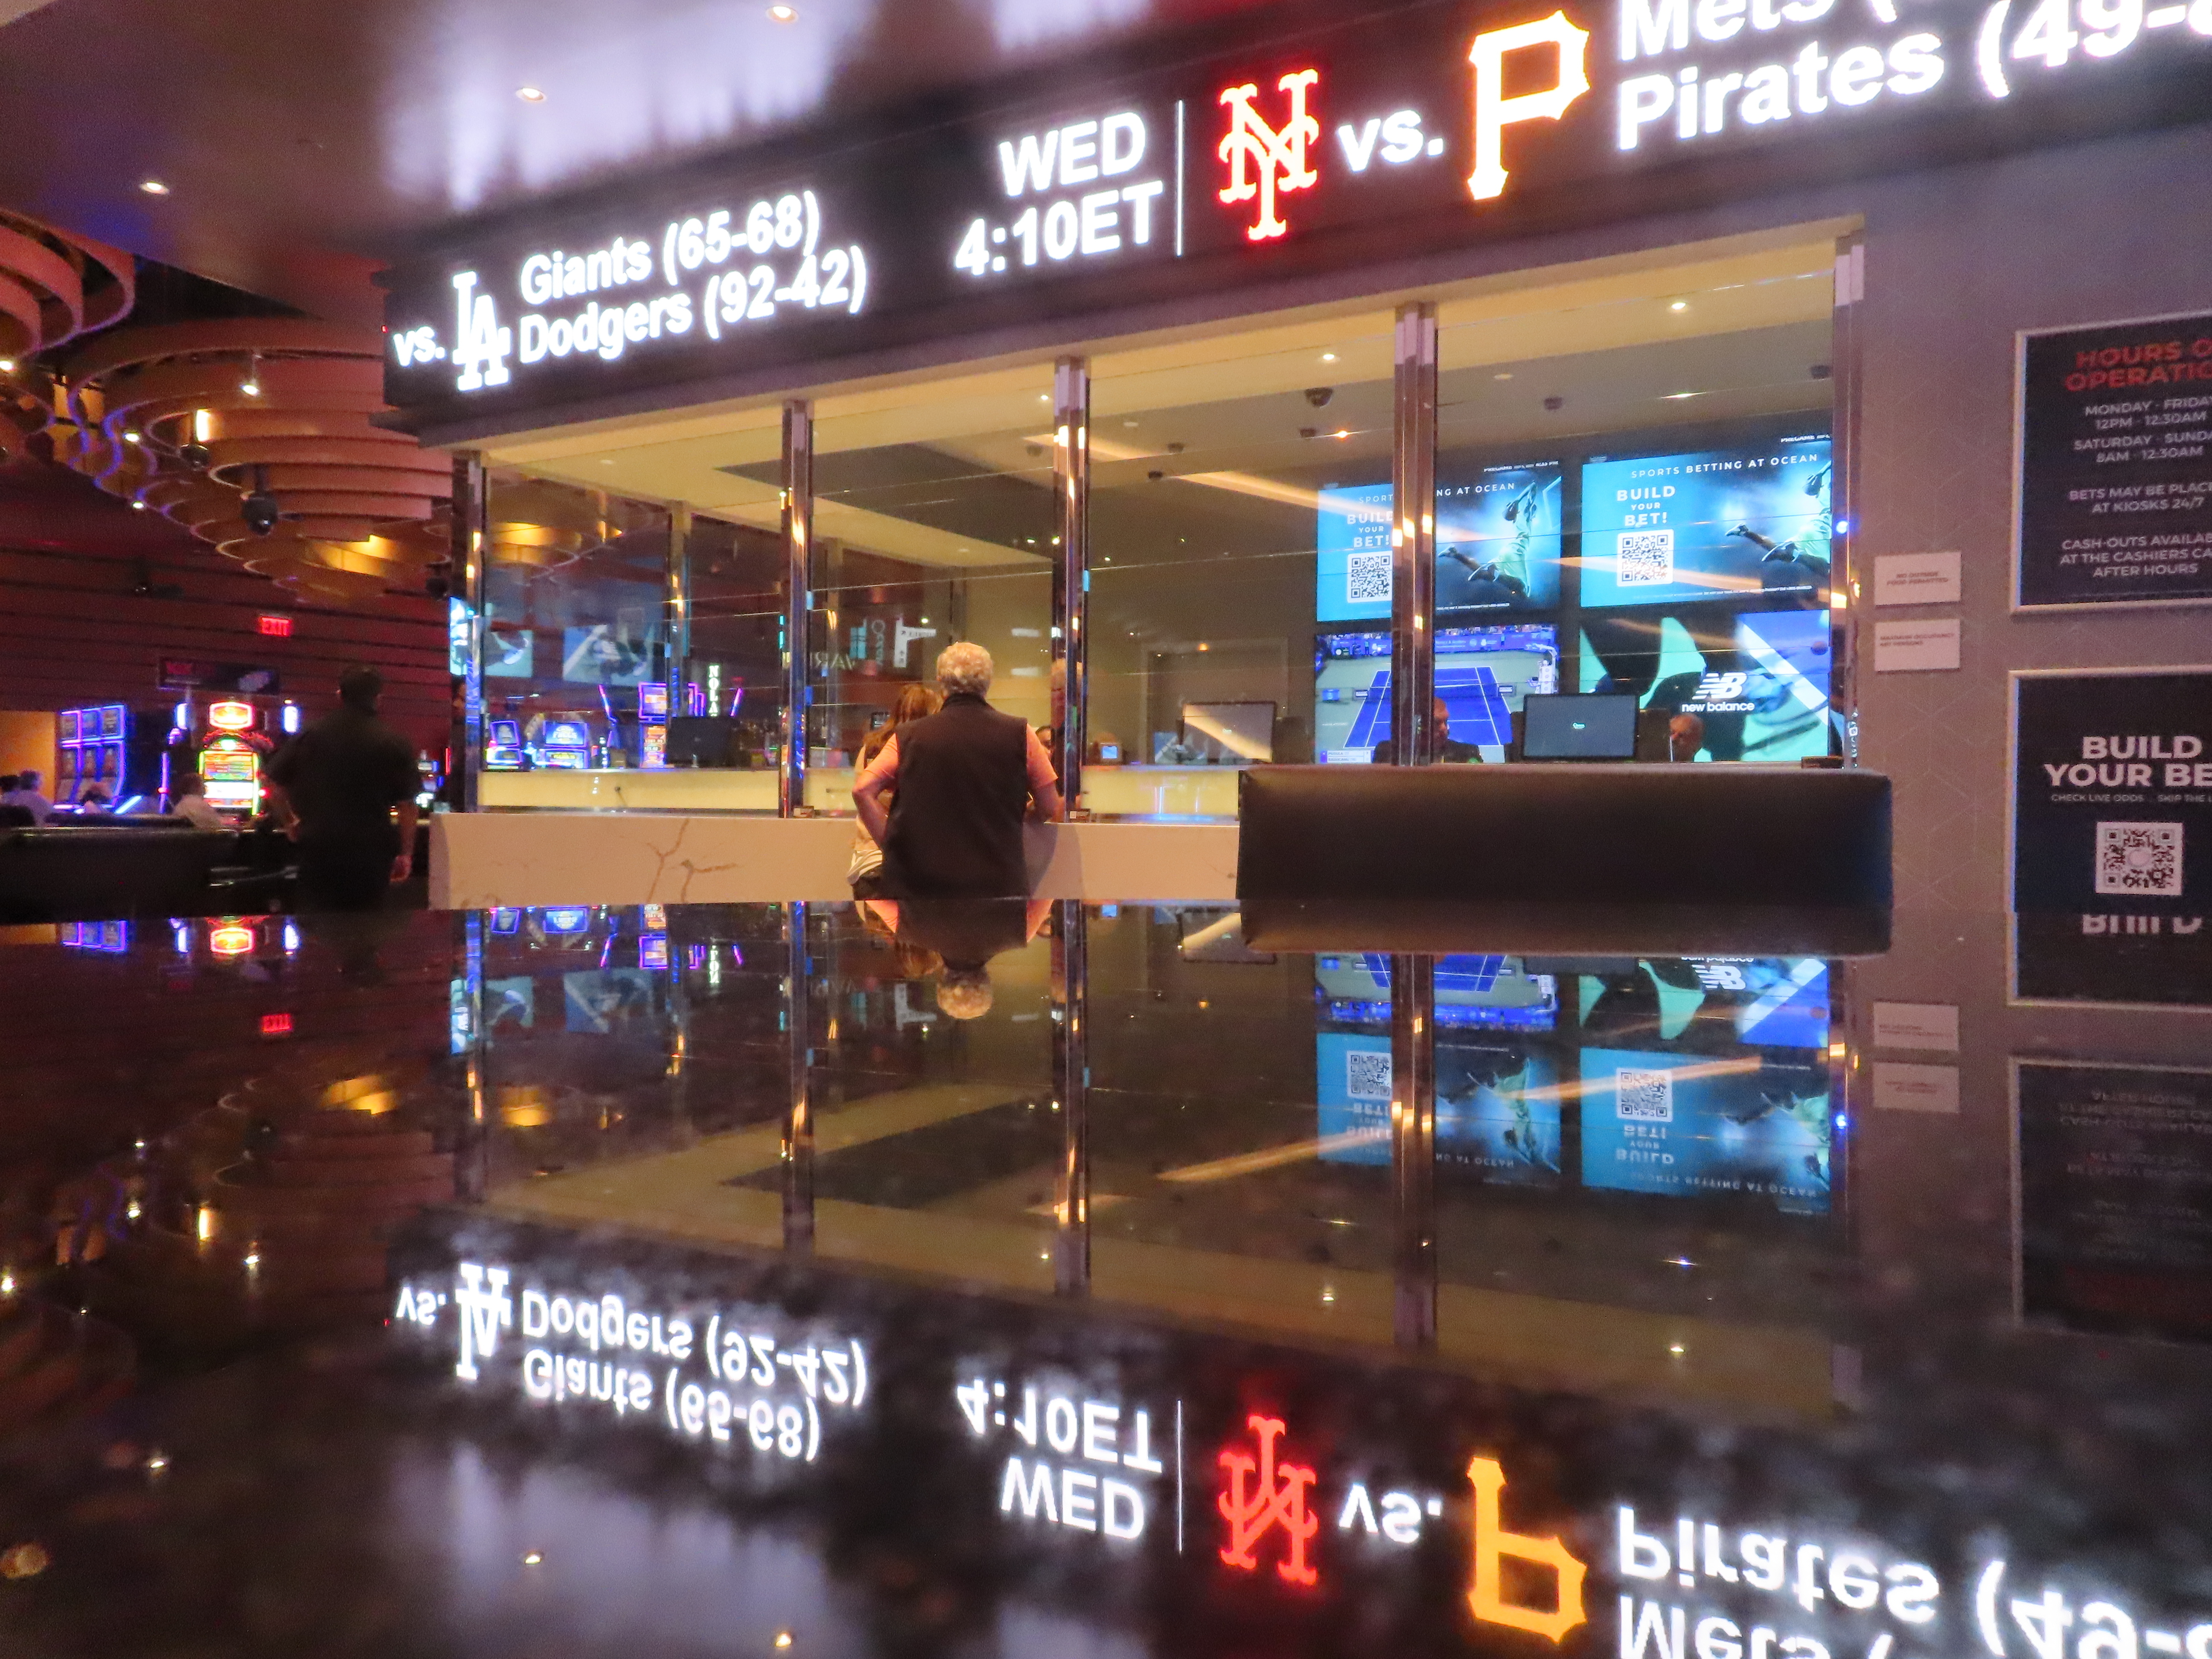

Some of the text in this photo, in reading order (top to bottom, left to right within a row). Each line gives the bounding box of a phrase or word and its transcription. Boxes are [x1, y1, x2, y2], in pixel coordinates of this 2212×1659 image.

[1620, 30, 1944, 150] Pirates
[1337, 110, 1444, 173] vs.
[1467, 9, 1591, 201] P
[999, 111, 1147, 196] WED
[955, 180, 1164, 275] 4:10ET
[521, 190, 820, 305] Giants (65-68)
[520, 245, 868, 361] Dodgers (92-42)
[393, 271, 510, 391] vs. LA
[2076, 342, 2181, 368] HOURS
[2085, 401, 2152, 416] MONDAY
[2074, 435, 2152, 450] SATURDAY
[1631, 453, 1818, 478] SPORTS BETTING AT OCEAN
[1359, 493, 1394, 504] SPORT
[1456, 486, 1470, 495] AT
[1475, 483, 1515, 494] OCEAN
[1617, 486, 1676, 501] BUILD
[2069, 489, 2106, 501] BETS
[2110, 486, 2141, 498] MAY
[2146, 484, 2165, 496] BE
[1631, 502, 1661, 510] YOUR
[2092, 496, 2205, 513] AT KIOSKS 24/7
[1624, 512, 1667, 527] BET!
[1353, 534, 1390, 547] BET!
[2060, 553, 2078, 565] AT
[2082, 553, 2110, 563] THE
[2113, 549, 2189, 562] CASHIERS
[2093, 563, 2198, 577] AFTER HOURS
[1682, 701, 1755, 712] new balance
[2082, 736, 2203, 759] BUILD
[2044, 763, 2152, 787] YOUR
[2052, 794, 2086, 802] CHECK
